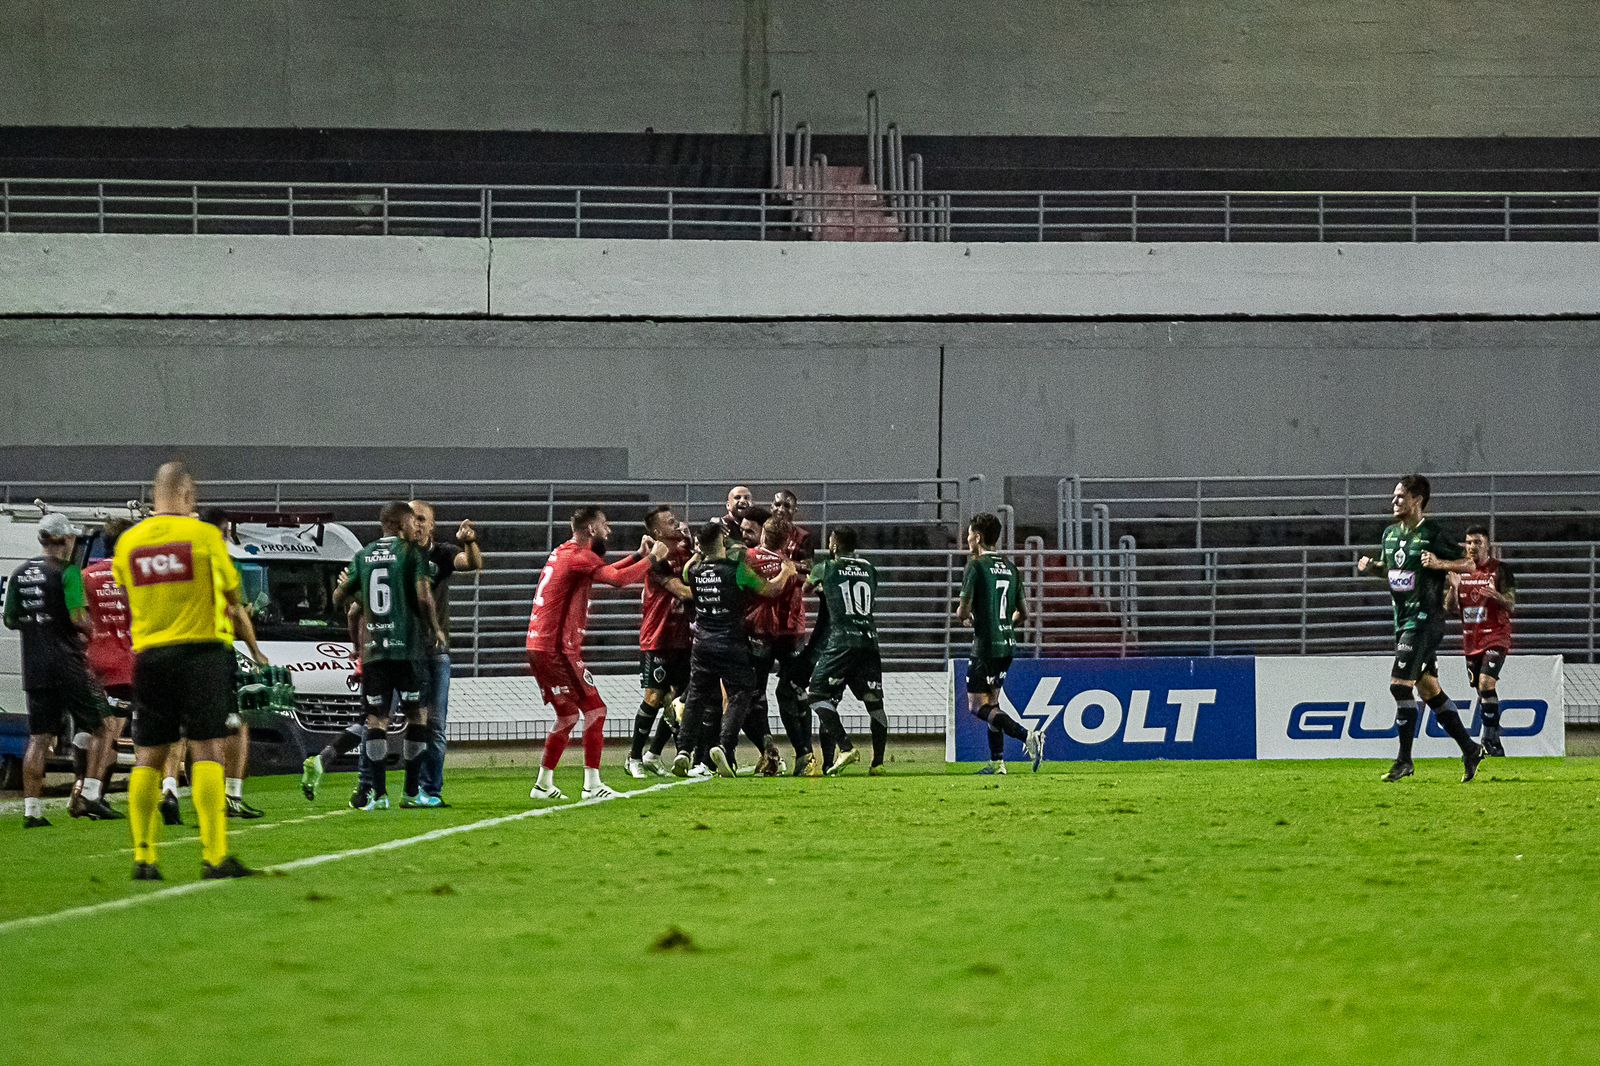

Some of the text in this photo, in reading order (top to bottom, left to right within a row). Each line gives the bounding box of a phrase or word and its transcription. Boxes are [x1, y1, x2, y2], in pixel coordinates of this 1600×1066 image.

[136, 553, 185, 577] TCL
[369, 567, 392, 616] 6
[838, 580, 871, 616] 10
[995, 580, 1010, 619] 7
